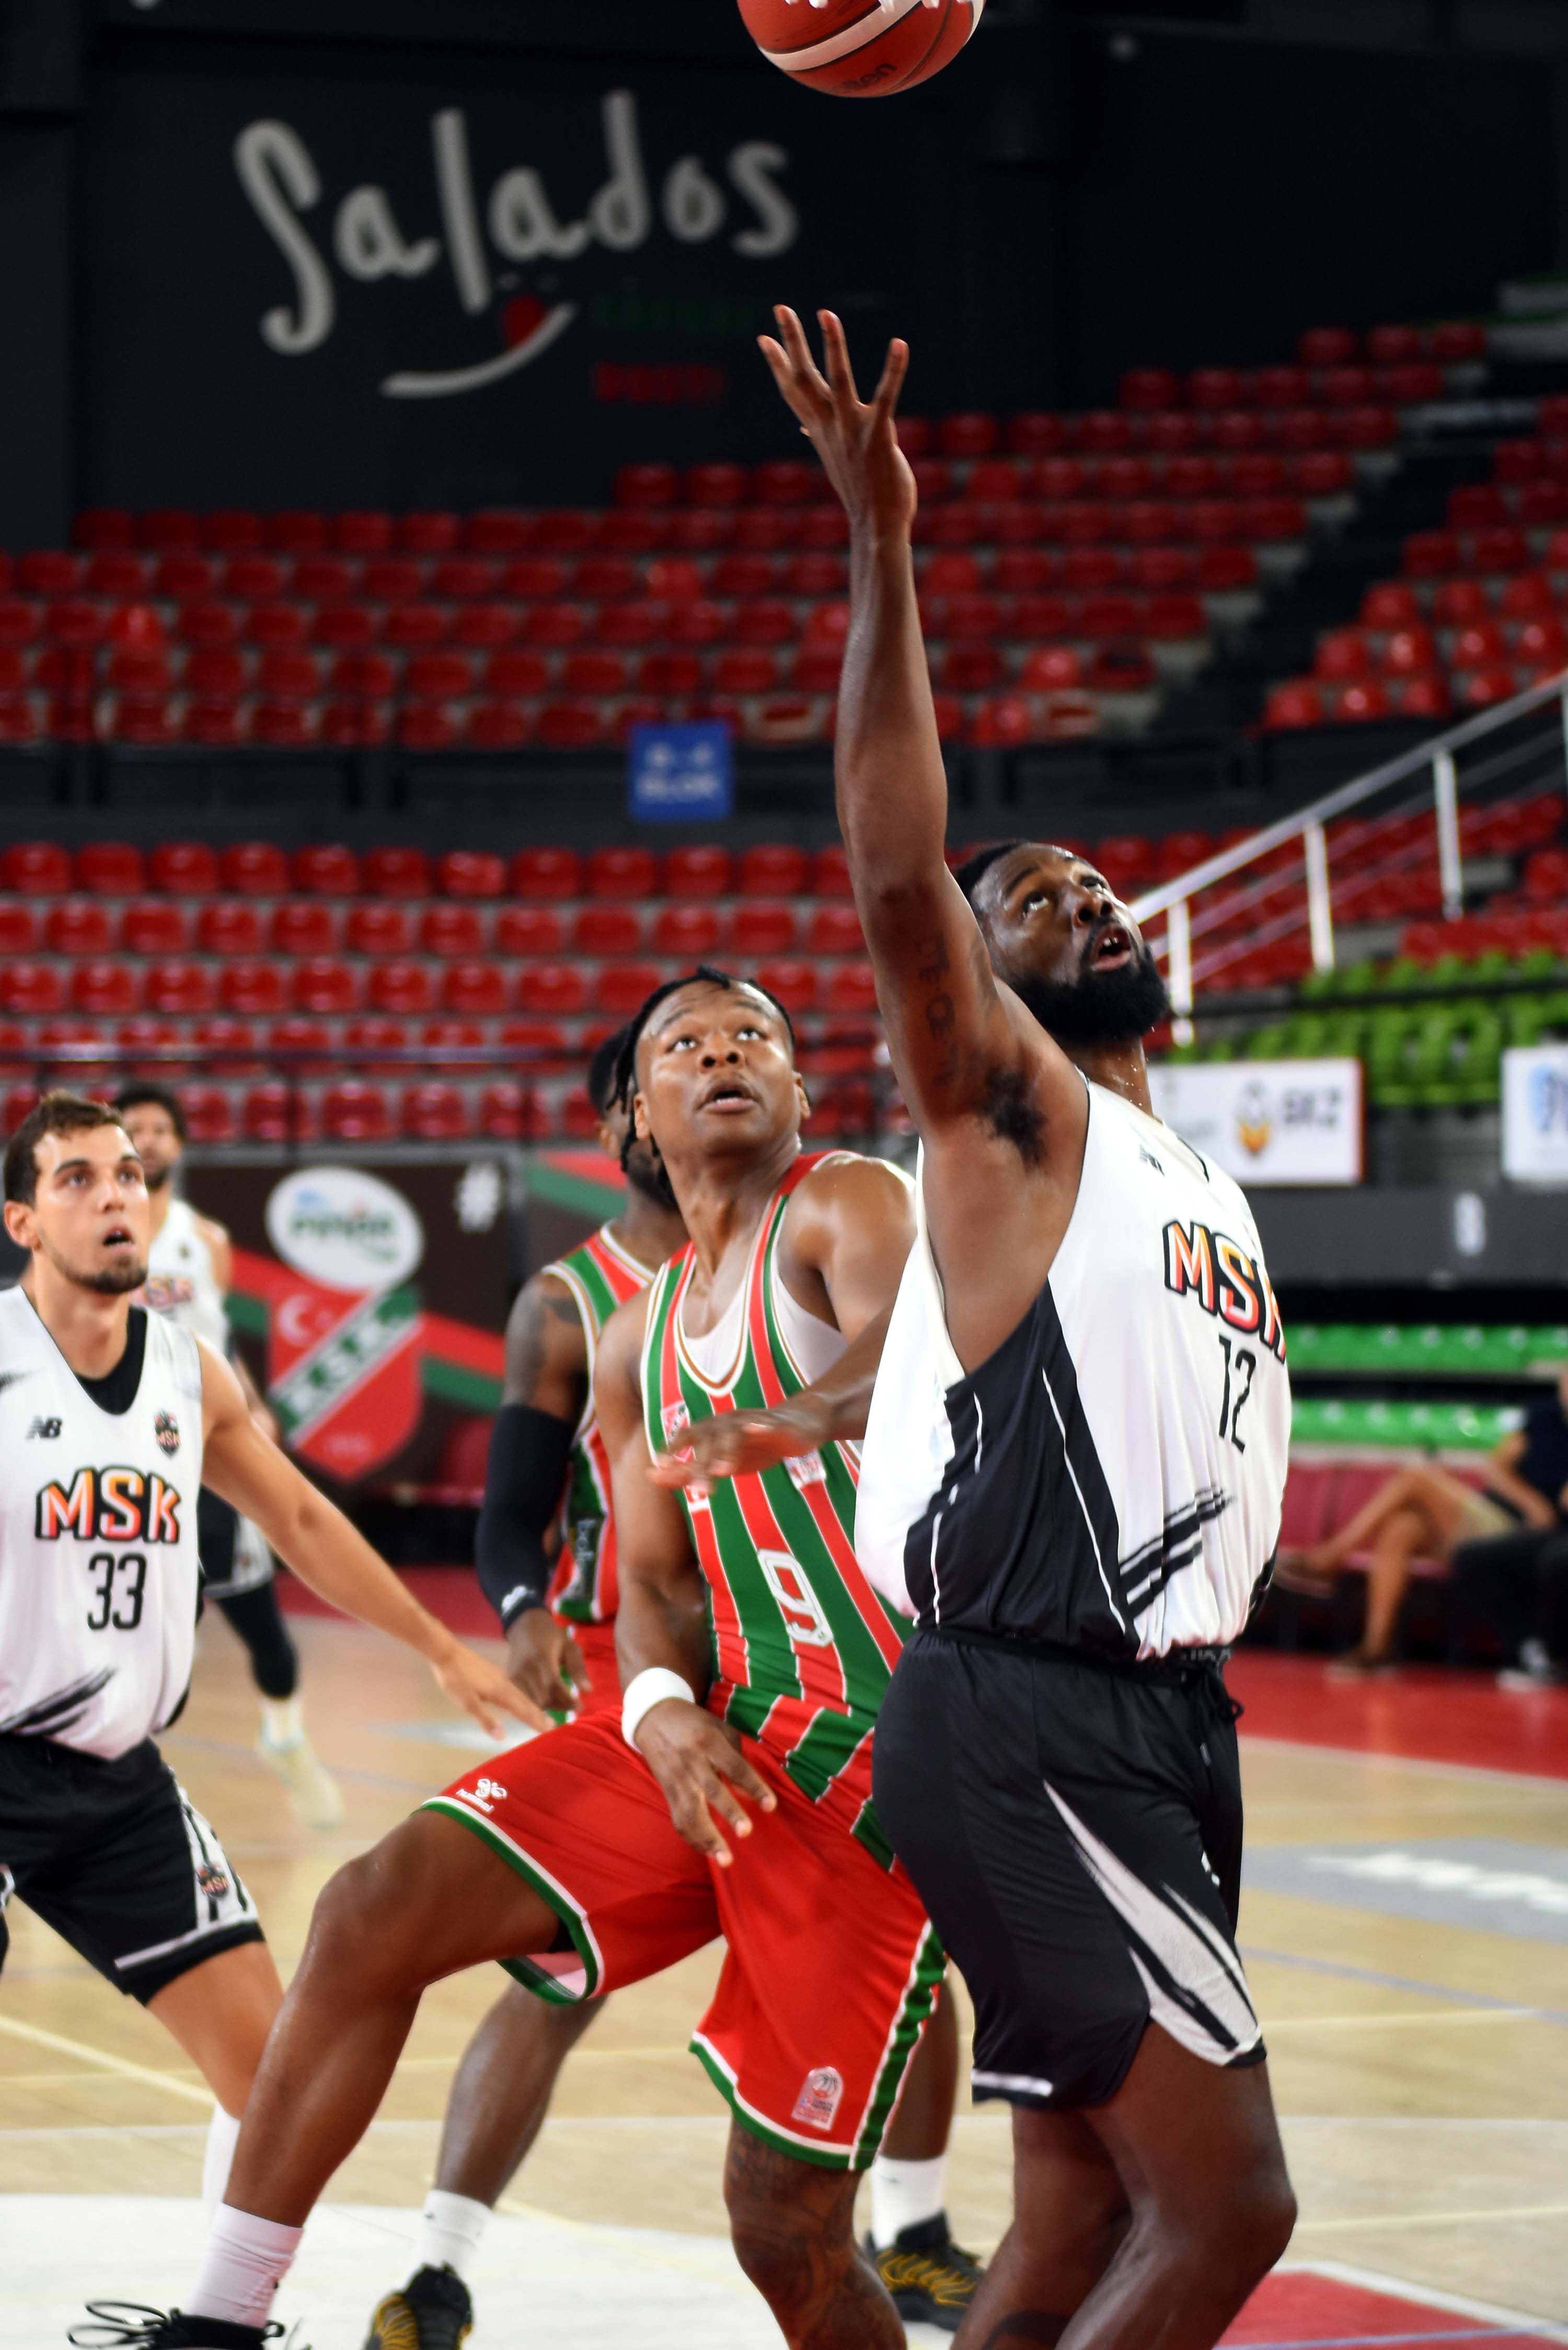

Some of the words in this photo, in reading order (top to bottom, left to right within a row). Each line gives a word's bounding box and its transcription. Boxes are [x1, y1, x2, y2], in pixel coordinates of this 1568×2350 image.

[235, 89, 799, 355] Salados
[1218, 1332, 1256, 1455] 12
[35, 1465, 181, 1543] MSK
[87, 1552, 147, 1630] 33
[757, 1548, 834, 1647] 9
